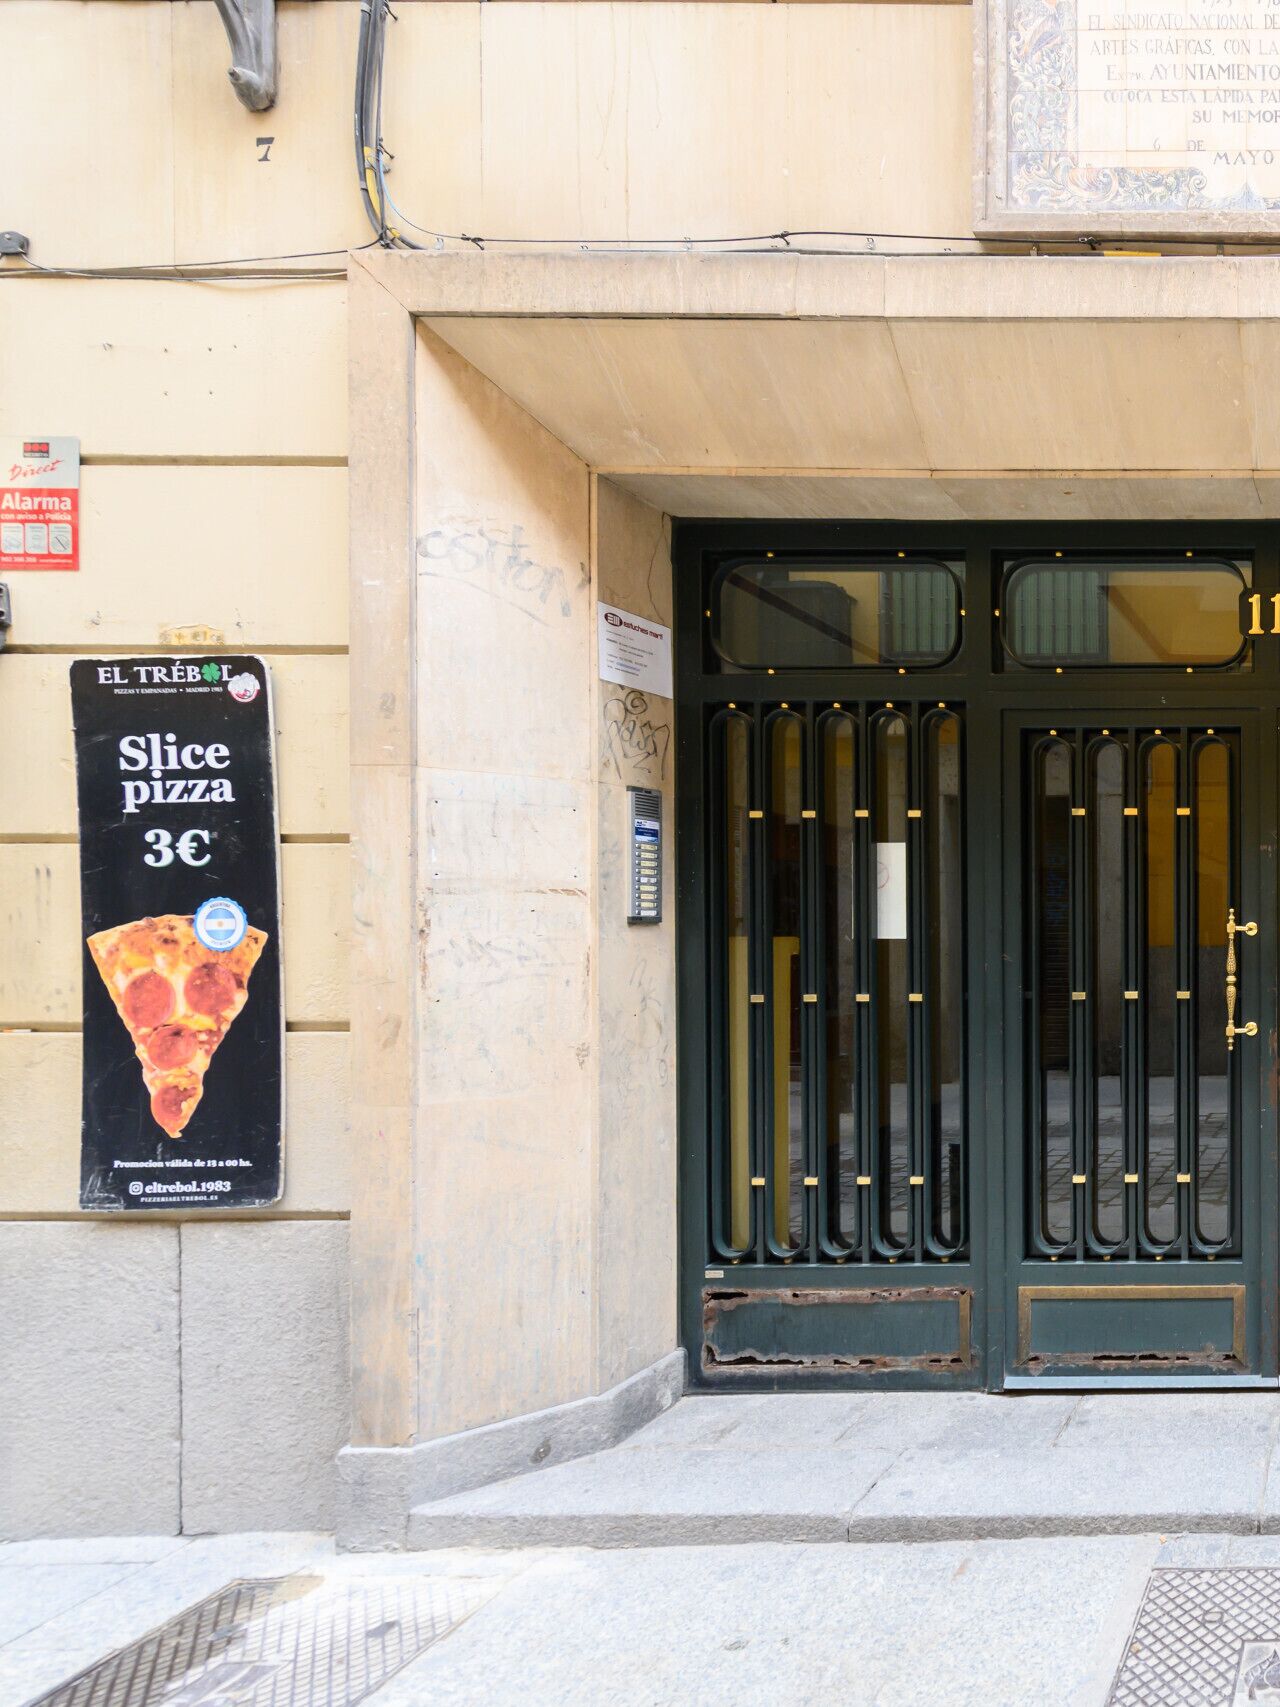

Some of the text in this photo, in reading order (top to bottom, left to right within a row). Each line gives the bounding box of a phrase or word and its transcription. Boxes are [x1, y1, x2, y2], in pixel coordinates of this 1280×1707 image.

[1088, 14, 1104, 30] EL
[1112, 14, 1182, 29] SINDICATO
[1189, 13, 1257, 29] NACIONAL
[1090, 39, 1138, 55] ARTES
[1224, 38, 1250, 55] CON
[1259, 39, 1279, 55] LA
[1150, 64, 1280, 80] AYUNTAMIENTO
[1161, 89, 1197, 103] ESTA
[1192, 110, 1212, 123] SU
[256, 137, 275, 162] 7
[1152, 137, 1160, 152] 6
[1187, 140, 1206, 152] DE
[1213, 150, 1274, 165] MAYO
[2, 492, 72, 511] Alarma
[16, 512, 37, 520] aviso
[97, 666, 128, 684] EL
[185, 686, 210, 694] MADRID
[119, 733, 231, 772] Slice
[121, 770, 236, 813] pizza
[143, 828, 212, 868] 3€
[113, 1160, 164, 1168] Promocion
[165, 1159, 193, 1168] válida
[194, 1159, 206, 1167] de
[239, 1158, 253, 1167] hs.
[144, 1181, 232, 1193] eltrebol.1983
